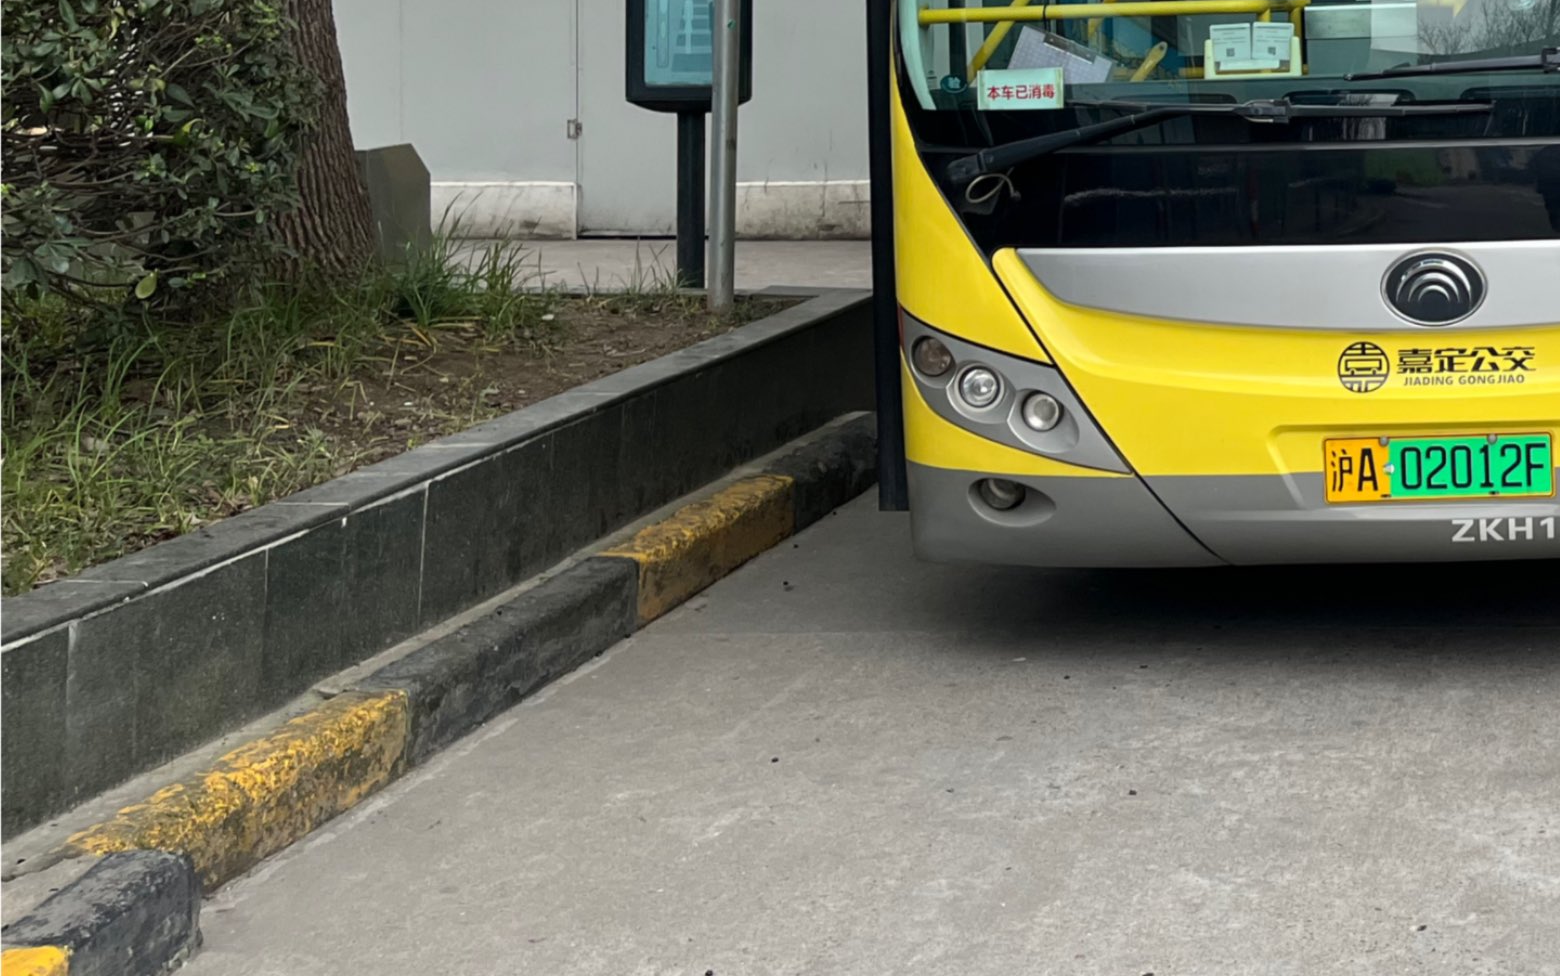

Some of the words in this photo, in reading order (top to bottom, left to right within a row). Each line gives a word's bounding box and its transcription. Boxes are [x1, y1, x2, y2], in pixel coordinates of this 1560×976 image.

[987, 84, 1056, 100] 本车已消毒
[1397, 346, 1535, 374] 嘉定公交
[1404, 376, 1454, 386] JIADING
[1400, 443, 1547, 490] 02012F
